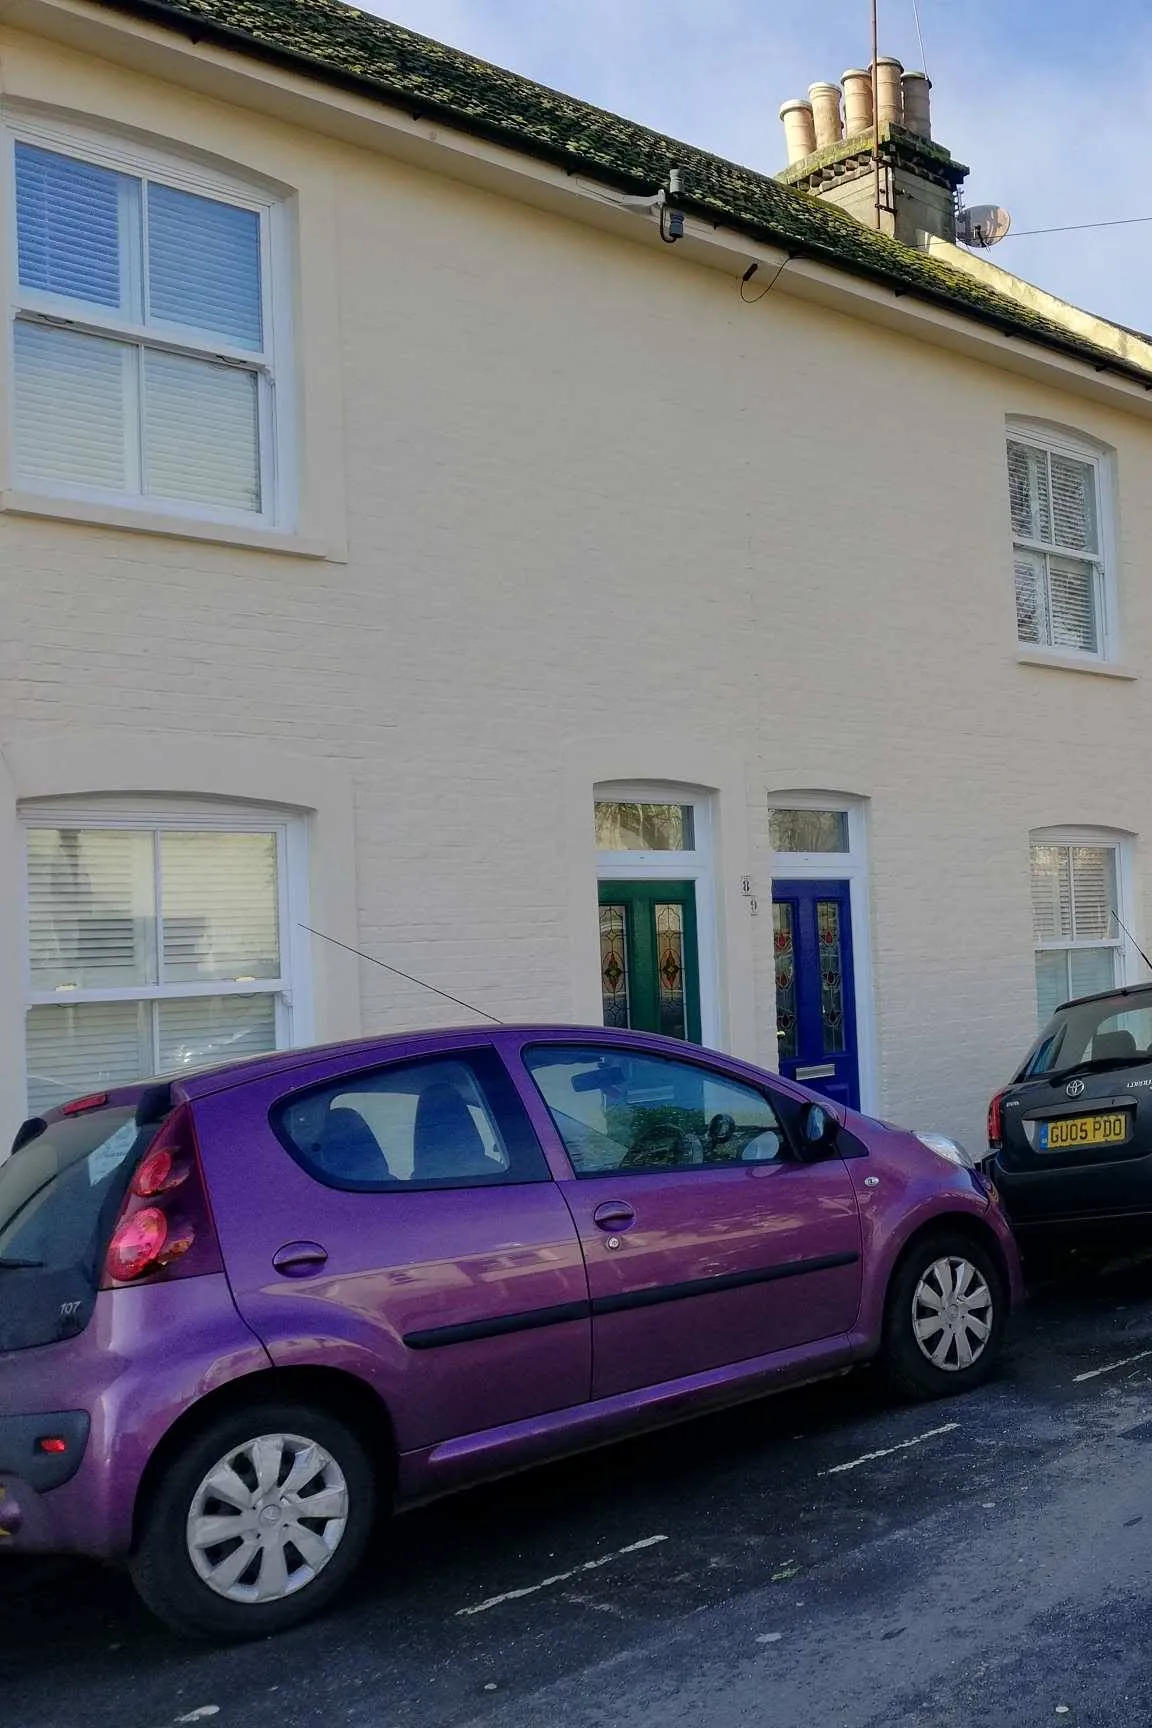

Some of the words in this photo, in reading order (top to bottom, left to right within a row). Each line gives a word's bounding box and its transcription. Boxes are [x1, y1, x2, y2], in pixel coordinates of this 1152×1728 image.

[1050, 1121, 1088, 1144] GU05
[1093, 1118, 1122, 1138] PDO
[60, 1300, 82, 1315] 107
